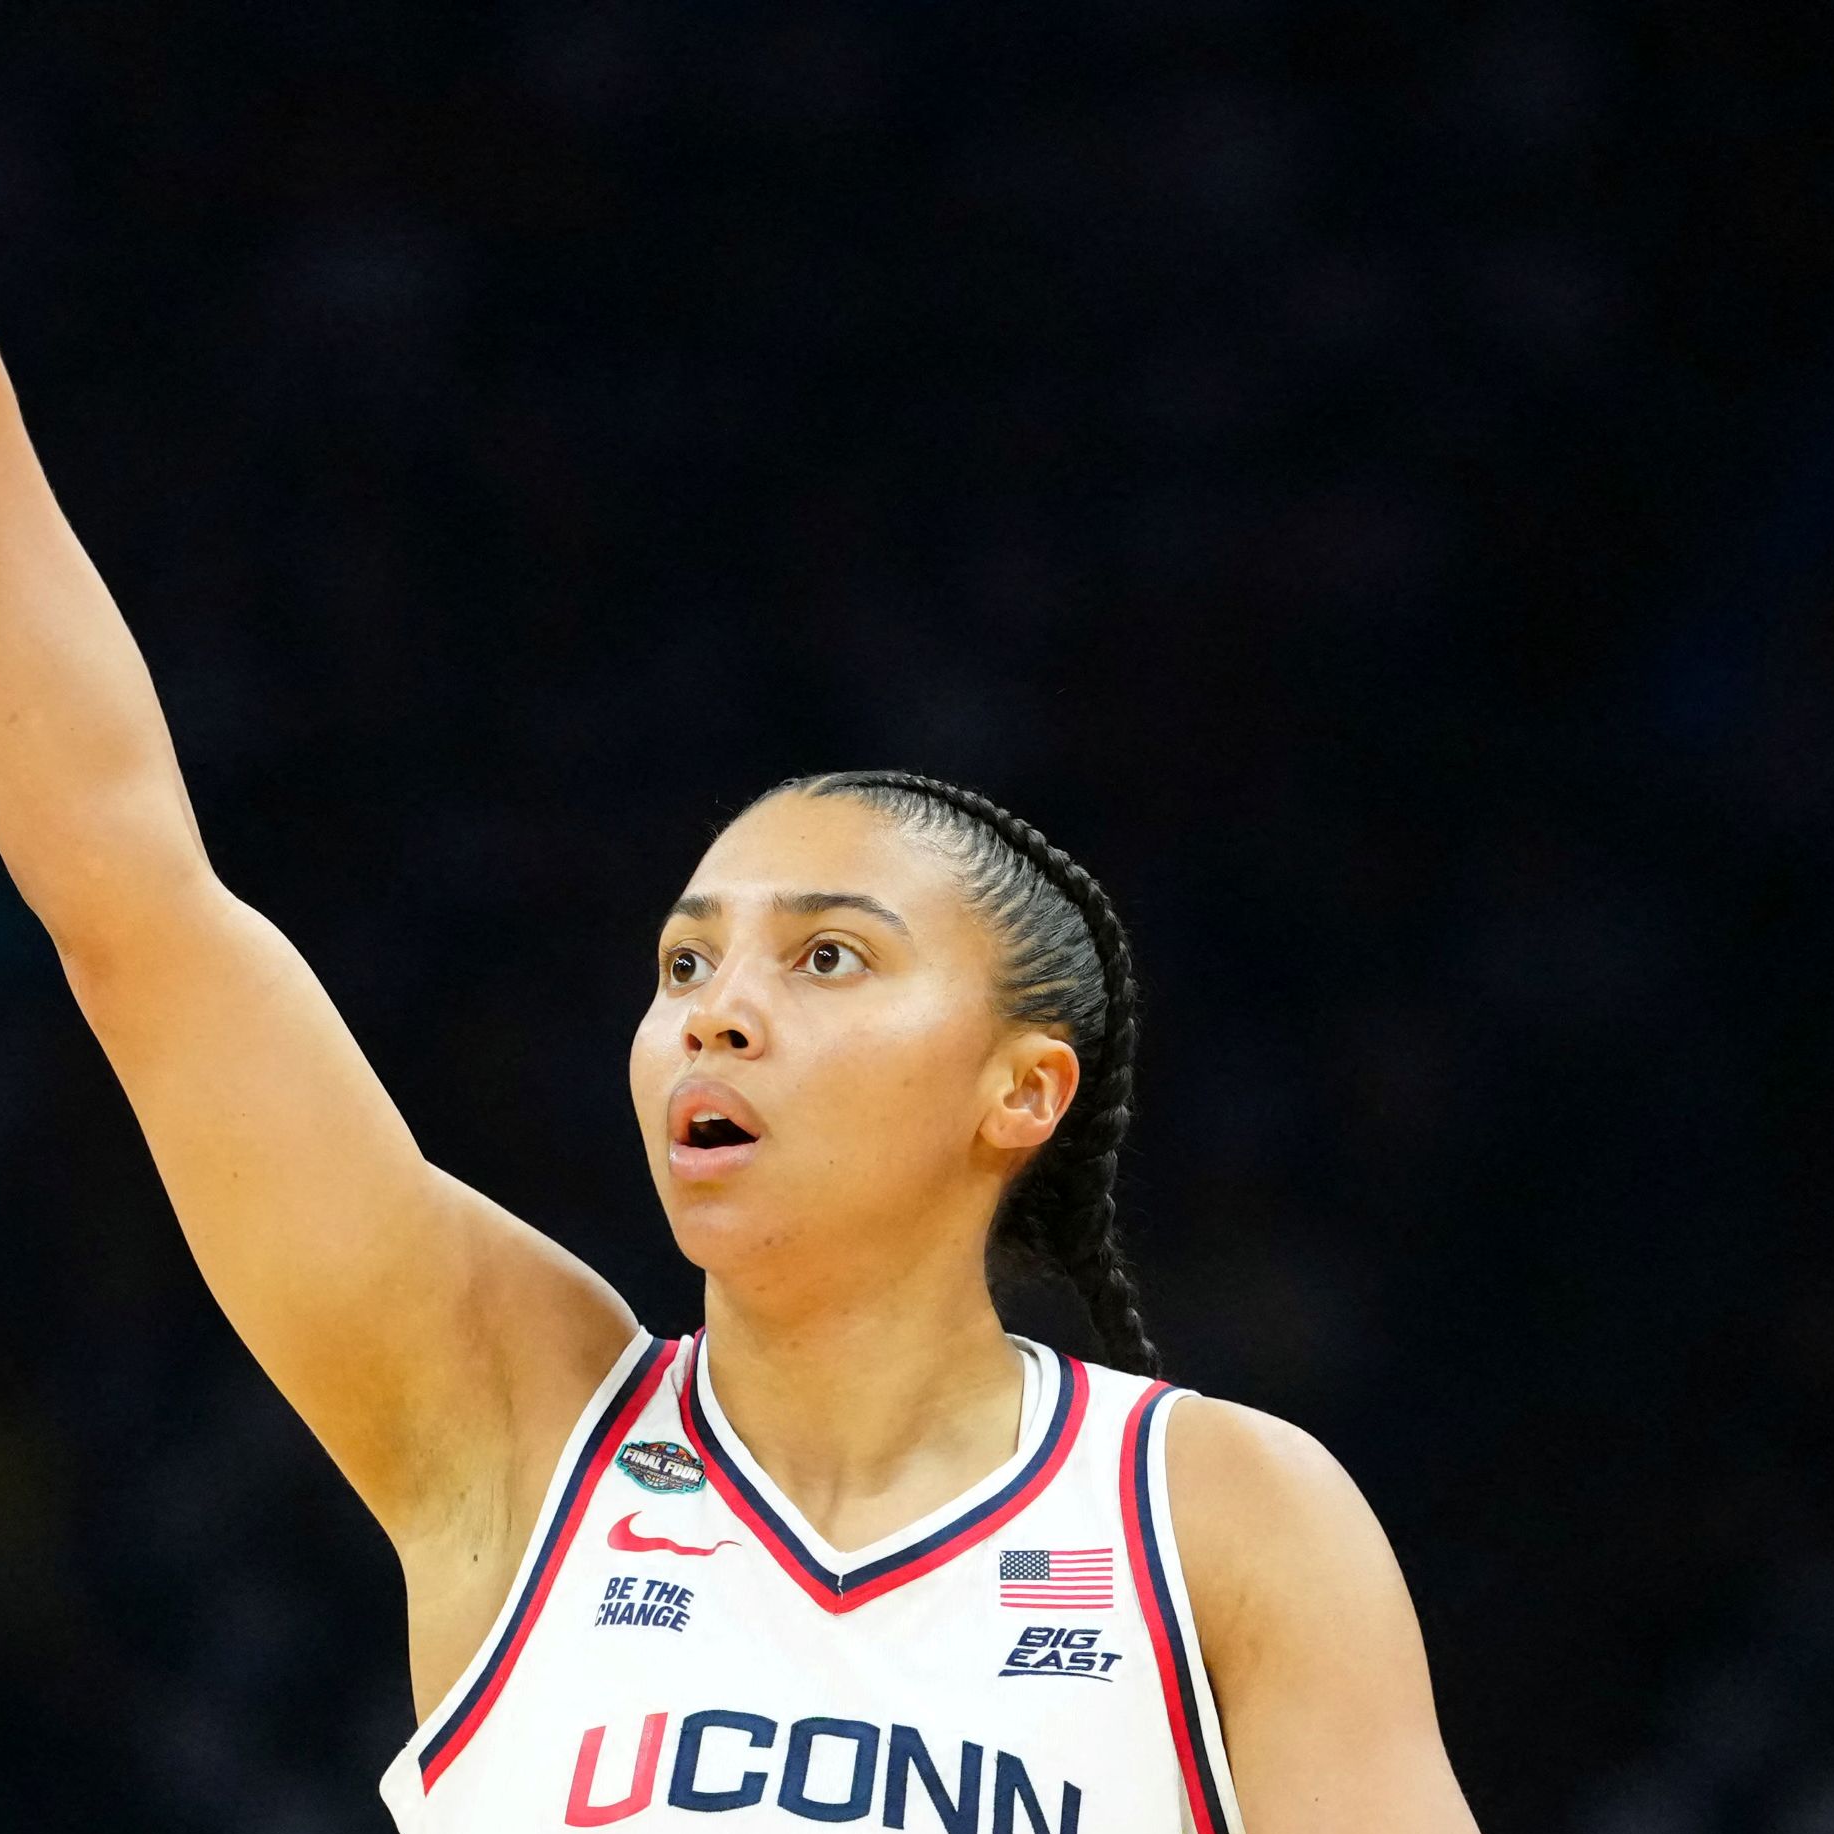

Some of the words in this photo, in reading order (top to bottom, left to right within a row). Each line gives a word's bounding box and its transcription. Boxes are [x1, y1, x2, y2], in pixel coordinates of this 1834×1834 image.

[622, 1447, 663, 1470] FINAL
[663, 1460, 703, 1482] FOUR
[604, 1577, 637, 1600] BE
[644, 1579, 694, 1610] THE
[595, 1602, 690, 1632] CHANGE
[1017, 1626, 1103, 1649] BIG
[1005, 1648, 1123, 1672] EAST
